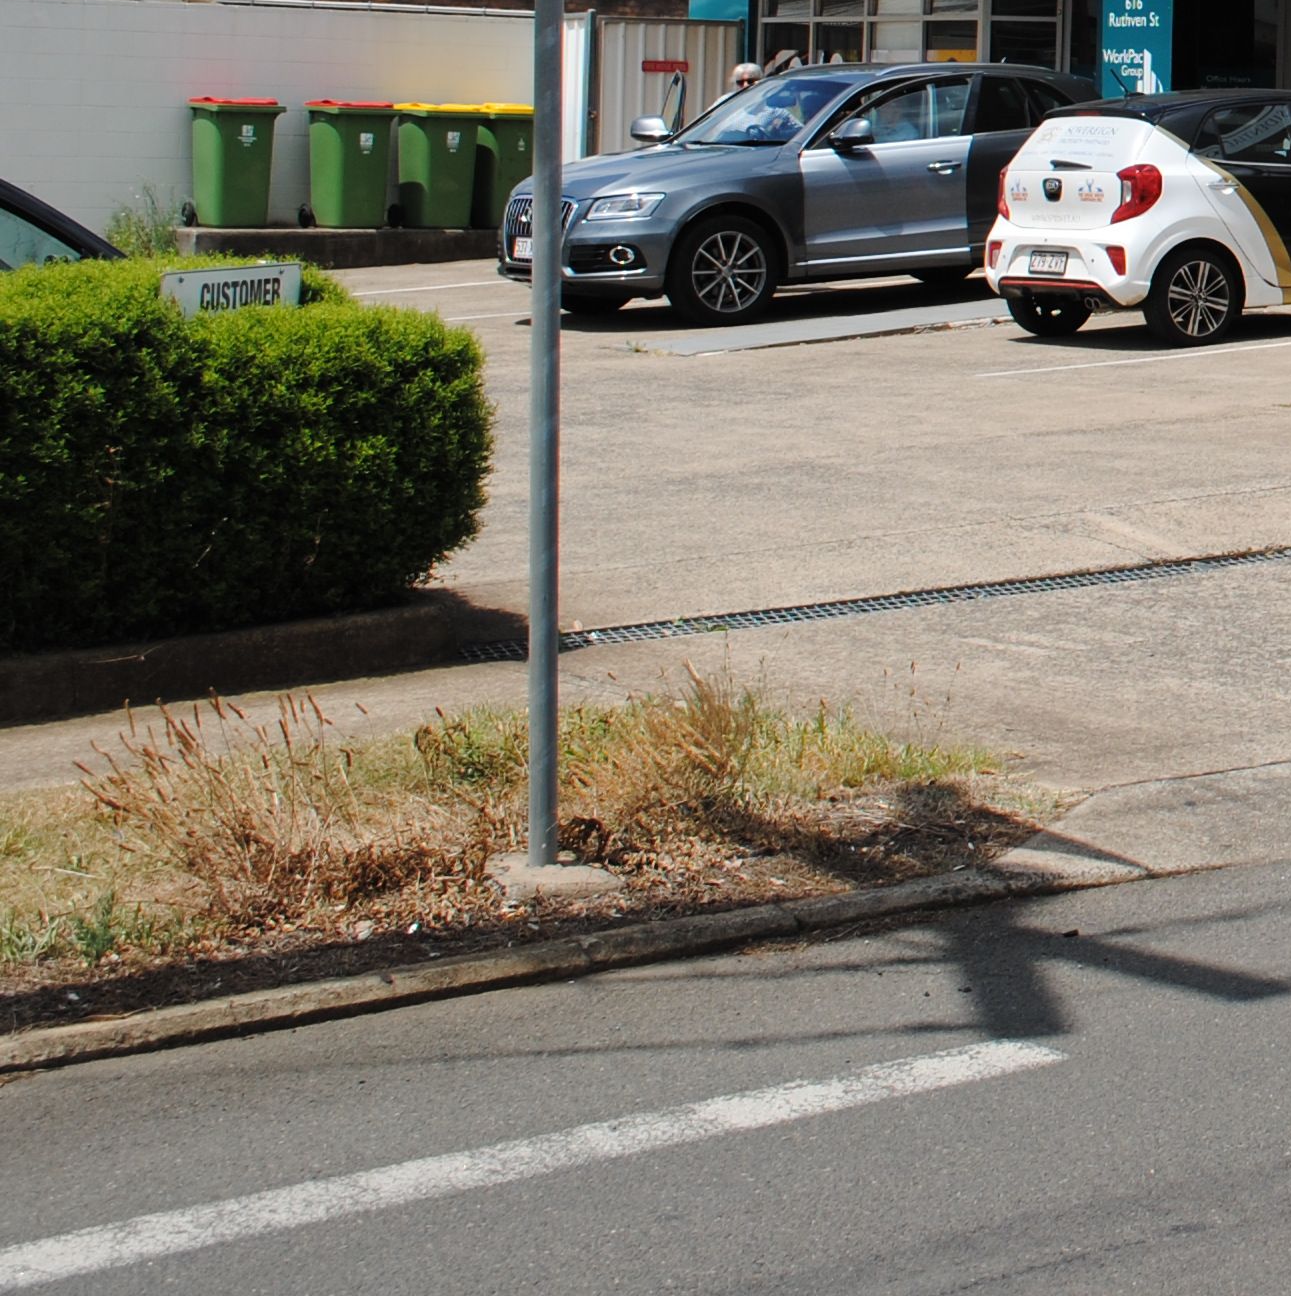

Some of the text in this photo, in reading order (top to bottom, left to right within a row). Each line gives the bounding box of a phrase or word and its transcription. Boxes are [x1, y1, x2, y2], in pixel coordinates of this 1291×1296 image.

[1108, 11, 1160, 27] Ruthven St
[1103, 48, 1144, 64] WorkPac
[1121, 65, 1143, 78] Group
[199, 277, 281, 310] CUSTOMER
